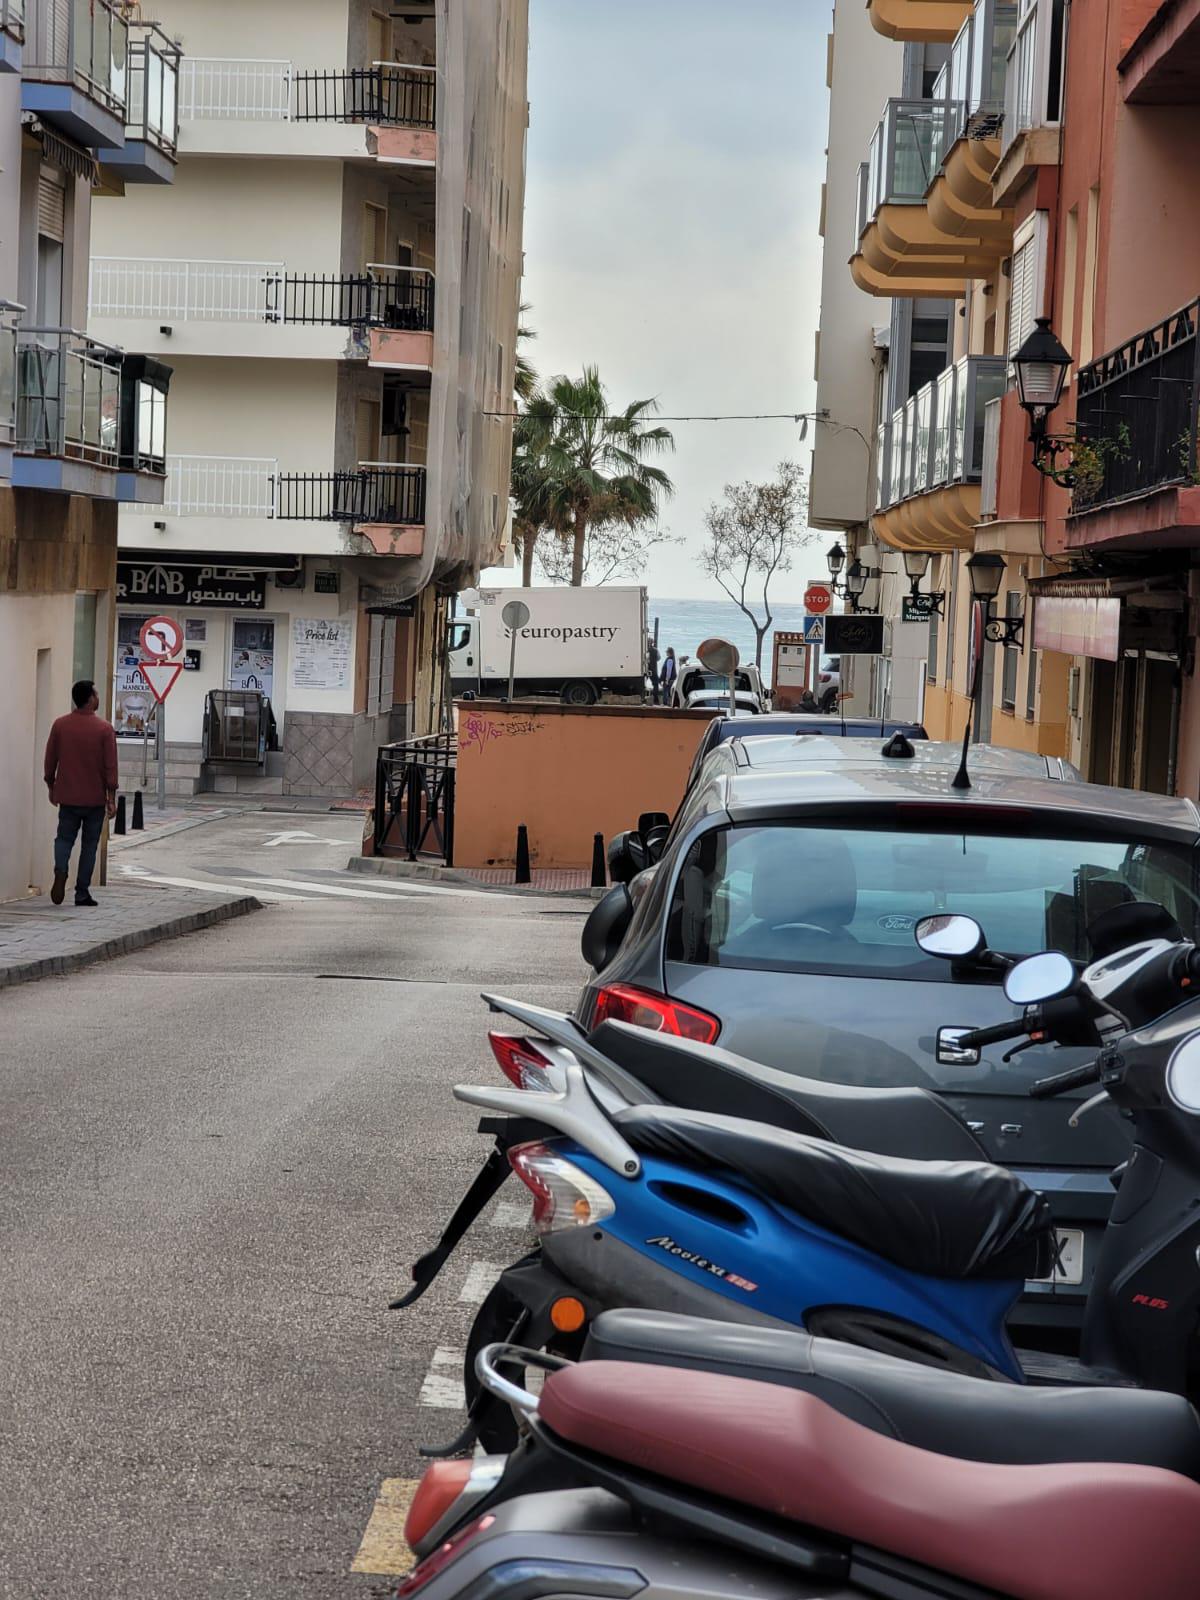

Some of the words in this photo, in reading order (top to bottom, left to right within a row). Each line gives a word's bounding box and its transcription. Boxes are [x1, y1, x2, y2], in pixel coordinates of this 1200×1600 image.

[130, 565, 185, 595] BAB
[305, 629, 326, 640] Price
[326, 628, 339, 640] list
[521, 626, 617, 642] europastry
[1132, 1294, 1169, 1309] PLUS
